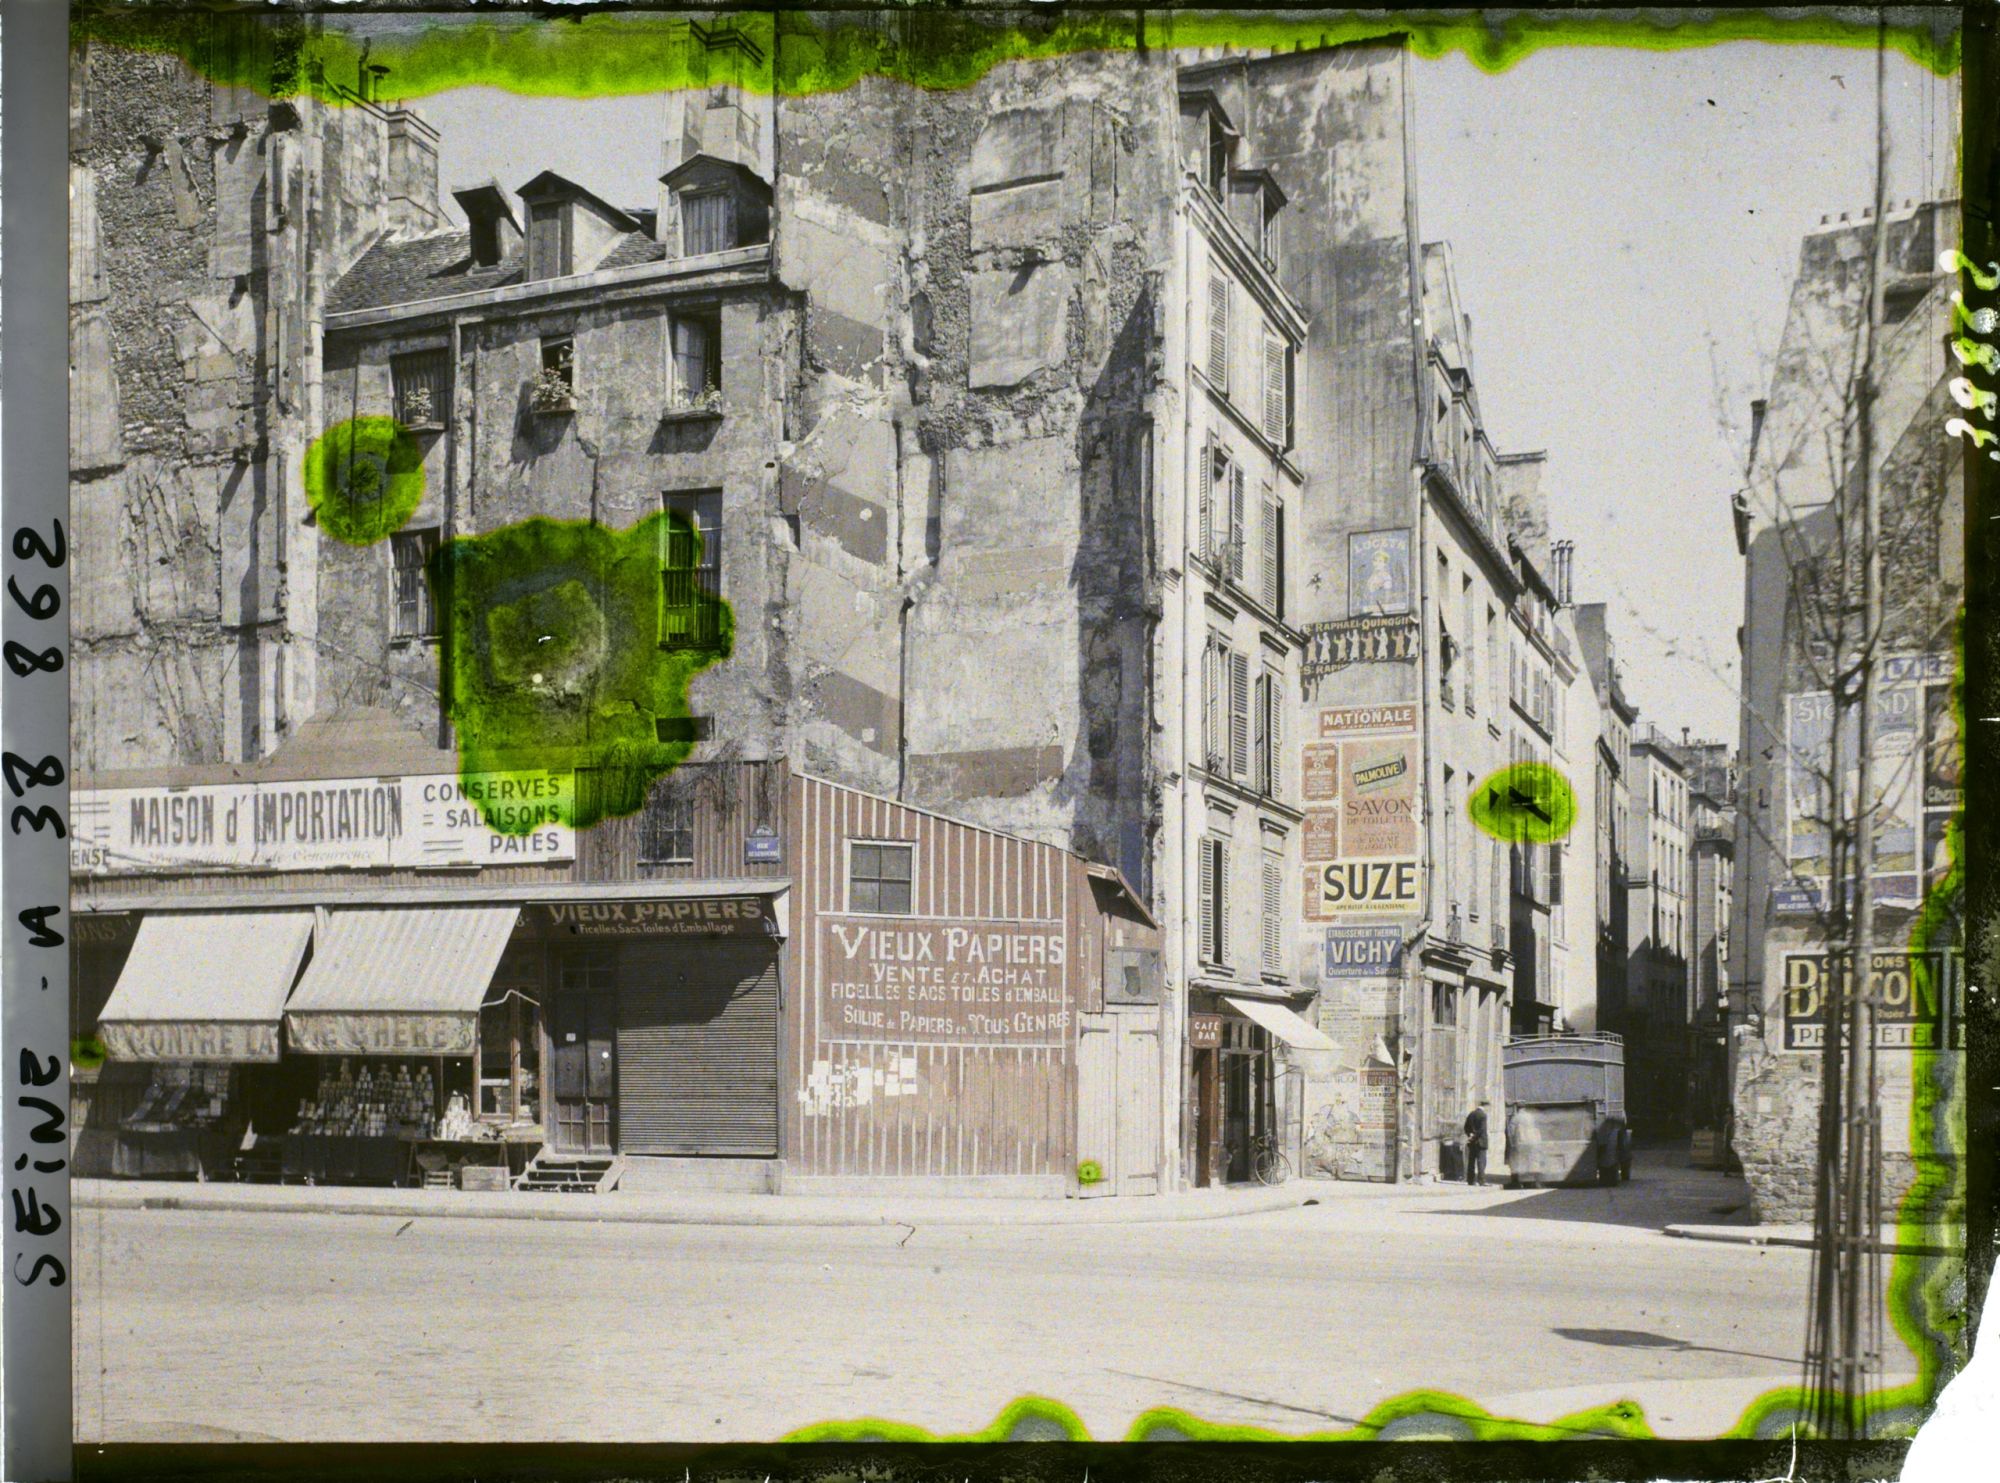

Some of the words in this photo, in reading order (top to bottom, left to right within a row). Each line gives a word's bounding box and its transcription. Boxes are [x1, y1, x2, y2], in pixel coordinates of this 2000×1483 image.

[3, 518, 66, 677] 862
[1323, 709, 1412, 726] NATIONALE
[1355, 763, 1400, 785] PALMOLIVE
[2, 752, 66, 839] 38
[423, 777, 560, 802] CONSERVES
[446, 804, 560, 828] SALAISONS
[1346, 798, 1413, 816] SAVON
[130, 795, 214, 845] MAISON
[490, 832, 559, 854] PATES
[1323, 862, 1416, 902] SUZE
[548, 904, 627, 926] VIEUX
[631, 900, 761, 923] PAPIERS
[19, 905, 64, 948] A
[579, 924, 617, 935] Ficelles
[617, 923, 640, 934] Sacs
[642, 922, 672, 934] Toiles
[1374, 927, 1401, 937] THERMAL
[831, 923, 936, 960] VIEUX
[942, 926, 1065, 965] PAPIERS
[1331, 939, 1397, 964] VICHY
[869, 963, 945, 984] VENTE
[950, 972, 971, 984] ET
[972, 965, 1048, 985] ACHAT
[1328, 966, 1362, 976] Ouverture
[1375, 965, 1399, 975] Saison
[831, 982, 901, 1001] FICELLES
[907, 985, 946, 1001] SACS
[950, 985, 1000, 1002] TOILES
[843, 1004, 885, 1029] SOLDE
[900, 1010, 954, 1035] PAPIERS
[968, 1013, 1010, 1035] TOUS
[1013, 1010, 1071, 1034] GENRES
[1194, 1021, 1219, 1031] CAFÉ
[1198, 1031, 1217, 1041] BAR
